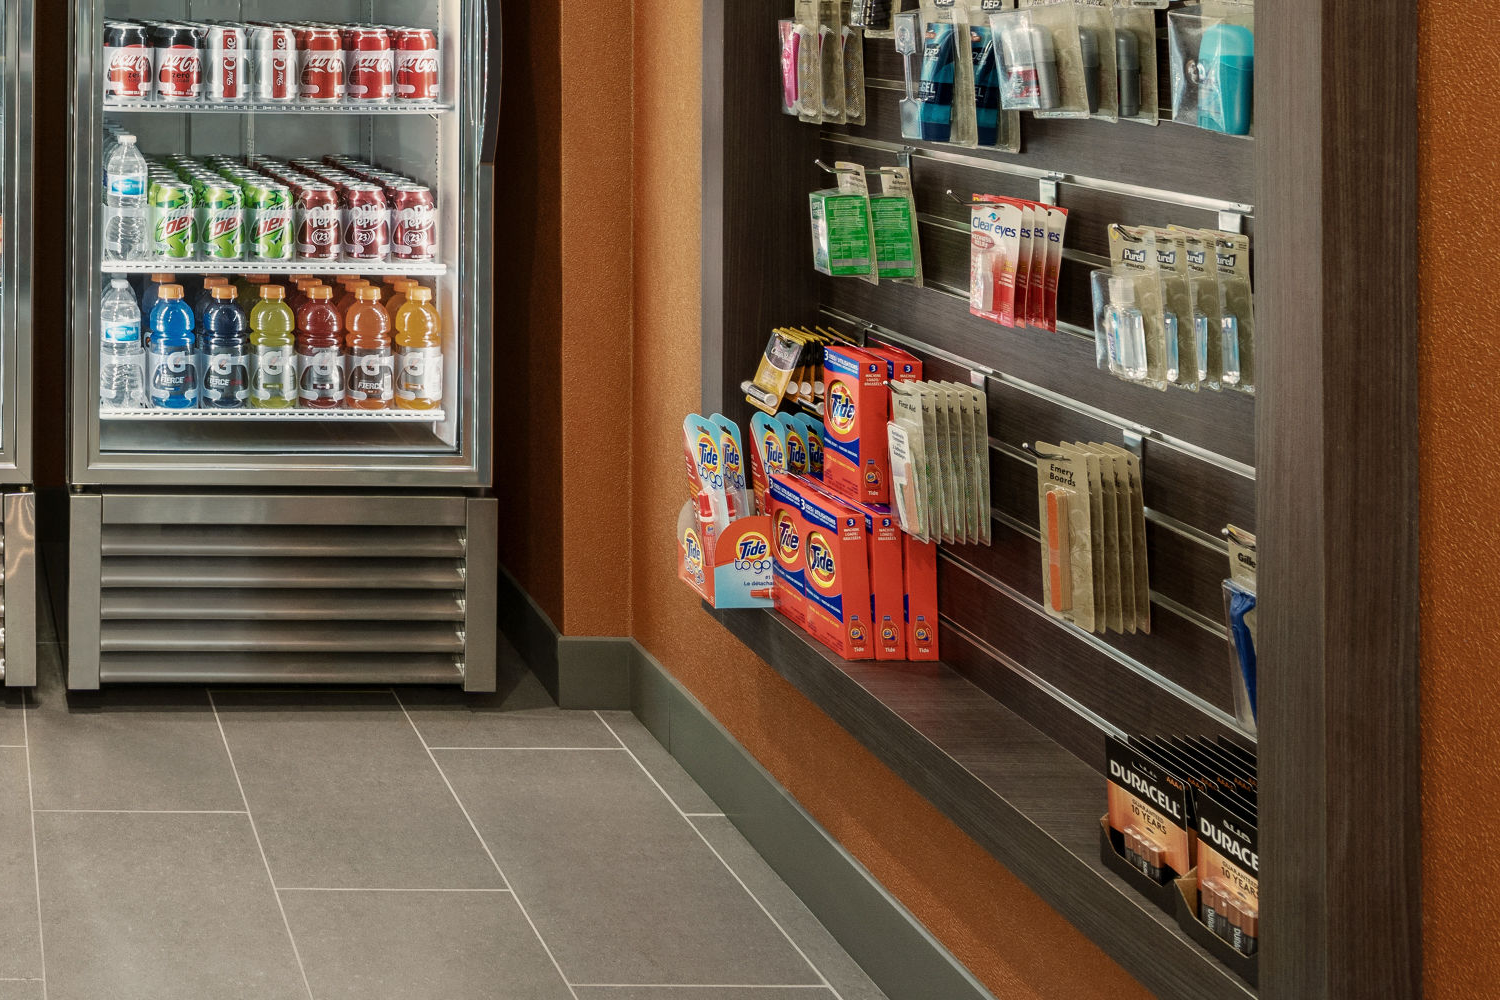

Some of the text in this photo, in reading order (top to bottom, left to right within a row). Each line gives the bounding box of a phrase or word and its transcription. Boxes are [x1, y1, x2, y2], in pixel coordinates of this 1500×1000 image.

[983, 0, 1000, 10] DEP
[920, 81, 936, 94] GEL
[972, 216, 1017, 239] Clear eyes
[410, 233, 420, 242] 23
[1124, 250, 1145, 263] Purell
[870, 364, 876, 373] 3
[906, 364, 911, 373] 3
[160, 376, 185, 384] FIERCE
[831, 393, 856, 420] Tide
[898, 399, 917, 413] First Aid
[699, 442, 719, 466] Tide
[723, 443, 740, 466] Tide
[765, 441, 783, 464] Tide
[788, 440, 806, 464] Tide
[1049, 463, 1074, 478] Emery
[709, 471, 723, 490] go
[732, 472, 745, 489] go
[1049, 472, 1077, 488] Boards
[800, 499, 806, 510] 3
[848, 518, 854, 527] 3
[884, 518, 890, 527] 3
[779, 520, 799, 549] Tide
[686, 537, 701, 560] Tide
[740, 540, 767, 560] Tide
[734, 557, 771, 574] to go
[811, 543, 834, 573] Tide
[1110, 759, 1182, 820] DURACELL
[1132, 798, 1165, 824] GUARANTEED
[1131, 805, 1167, 835] 10 YEARS
[1221, 867, 1231, 880] 10
